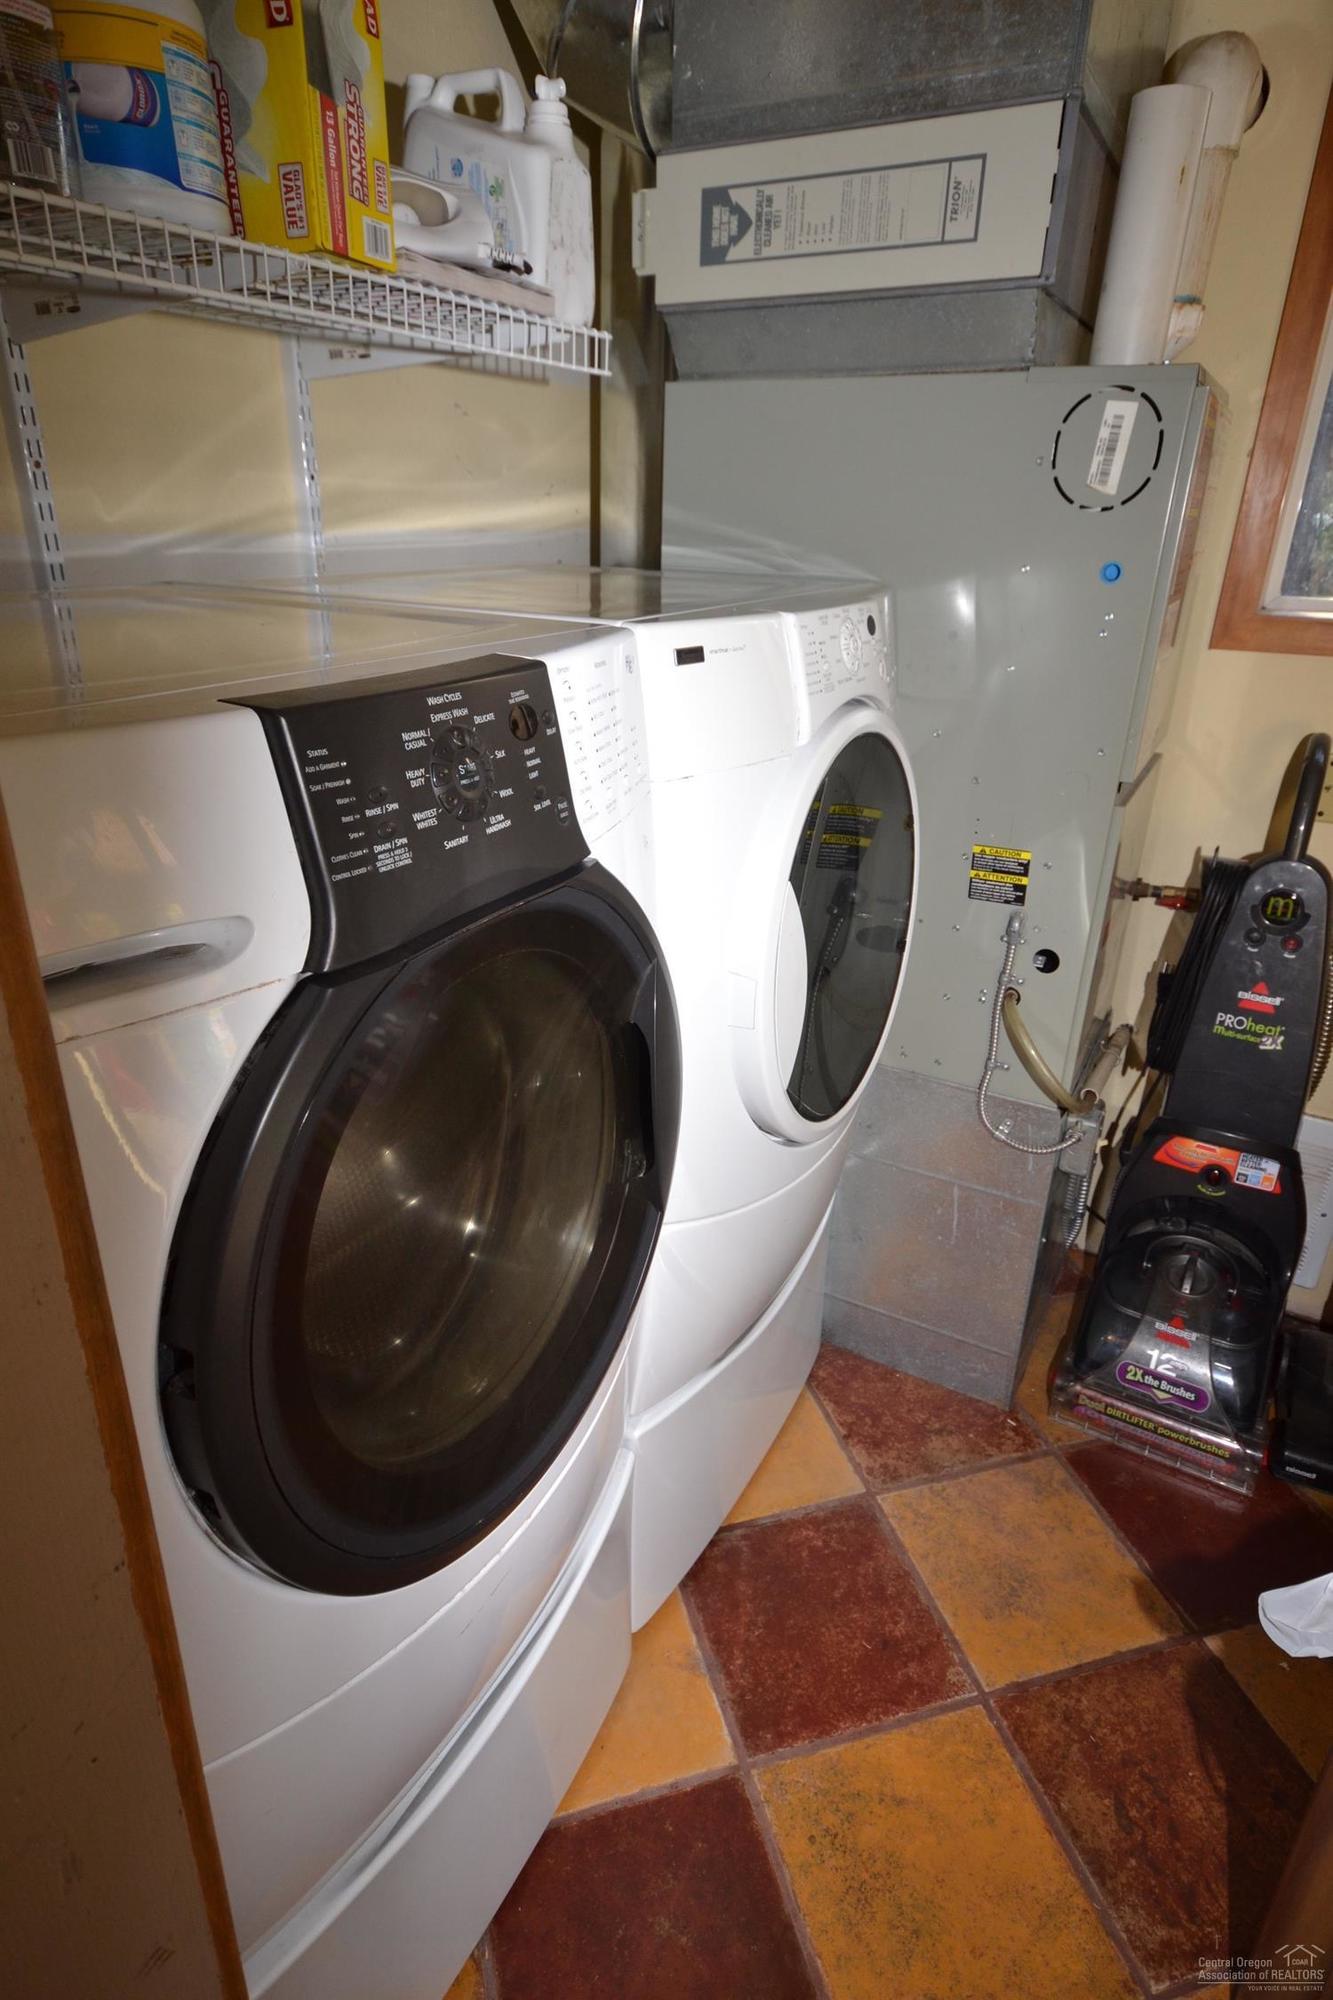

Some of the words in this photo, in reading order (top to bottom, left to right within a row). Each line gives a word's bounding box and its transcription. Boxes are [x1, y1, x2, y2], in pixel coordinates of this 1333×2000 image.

[325, 110, 334, 124] 13
[326, 129, 337, 168] Gallon
[345, 80, 364, 202] STRONG
[359, 106, 370, 206] GUARANTEED
[217, 90, 245, 239] GUARANTEED
[292, 169, 304, 212] GLAD'S
[374, 163, 384, 208] VALUE
[280, 170, 300, 231] VALUE
[950, 179, 963, 223] TRION
[297, 217, 306, 231] #1
[763, 209, 773, 247] CLEANED
[426, 696, 444, 706] WASH
[444, 692, 463, 702] CYCLES
[430, 711, 453, 723] EXPRESS
[452, 708, 469, 718] WASH
[473, 713, 496, 724] DELICATE
[404, 738, 428, 751] CASUAL
[306, 748, 328, 759] STATUS
[405, 768, 426, 779] HEAVY
[410, 777, 426, 788] DUTY
[336, 797, 350, 806] WASH
[365, 807, 383, 818] RINSE
[386, 802, 399, 812] SPIN
[412, 808, 438, 822] WHITEST
[416, 817, 439, 830] WHITES
[489, 813, 505, 824] ULTRA
[373, 842, 391, 853] DRAIN
[394, 837, 408, 848] SPIN
[443, 835, 469, 850] SANITARY
[349, 849, 363, 858] CLEAN
[989, 848, 1023, 858] CAUTION
[376, 858, 393, 868] SECONDS
[378, 863, 395, 873] UNLOCK
[395, 858, 412, 868] CONTROL
[350, 867, 367, 877] LOCKED
[982, 873, 1023, 884] ATTENTION
[1215, 1012, 1282, 1037] PROheat
[1258, 1035, 1285, 1050] 2X
[1146, 1349, 1178, 1377] 12
[1125, 1366, 1143, 1383] 2X
[1144, 1374, 1161, 1389] the
[1159, 1379, 1197, 1402] Brushes
[1157, 1426, 1231, 1459] powerbrushes
